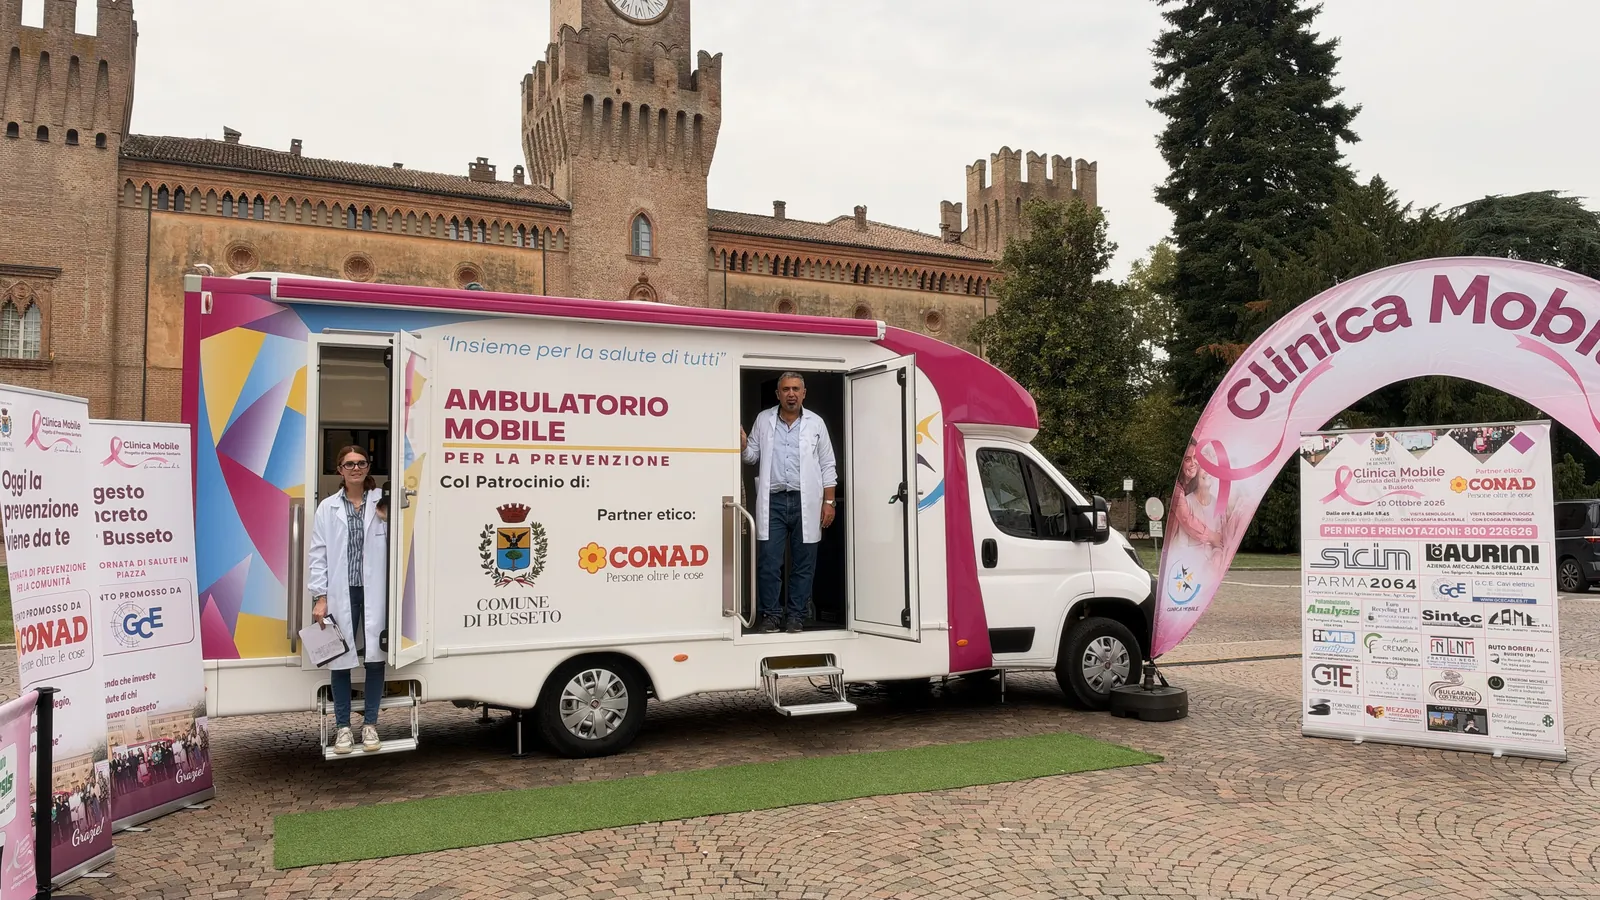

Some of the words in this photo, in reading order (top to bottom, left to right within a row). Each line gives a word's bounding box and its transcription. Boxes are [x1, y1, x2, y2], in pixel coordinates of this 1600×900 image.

[442, 335, 531, 356] “Insieme
[536, 343, 571, 360] per
[576, 343, 594, 360] la
[599, 346, 656, 364] salute
[662, 349, 678, 364] di
[684, 351, 726, 367] tutti”
[1227, 294, 1412, 420] Clinica
[1428, 274, 1600, 365] Mobi
[444, 388, 669, 417] AMBULATORIO
[42, 416, 61, 428] Clinica
[63, 419, 81, 430] Mobile
[444, 418, 566, 442] MOBILE
[123, 441, 151, 450] Clinica
[153, 442, 180, 450] Mobile
[444, 452, 485, 464] PER
[496, 453, 520, 465] LA
[530, 454, 670, 467] PREVENZIONE
[1353, 468, 1396, 478] Clinica
[1400, 467, 1445, 477] Mobile
[2, 468, 27, 496] Oggi
[30, 470, 42, 490] la
[440, 476, 470, 488] Col
[476, 476, 565, 488] Patrocinio
[570, 476, 590, 488] di:
[1468, 477, 1536, 490] CONAD
[93, 484, 144, 505] gesto
[4, 498, 79, 527] prevenzione
[597, 509, 652, 522] Partner
[656, 508, 696, 521] etico:
[103, 529, 173, 545] Busseto
[1379, 527, 1462, 535] PRENOTAZIONI:
[1489, 528, 1532, 536] 226626
[6, 529, 30, 551] viene
[33, 528, 51, 547] da
[55, 528, 70, 546] te
[99, 560, 135, 569] ORNATA
[149, 557, 178, 565] SALUTE
[609, 544, 709, 568] CONAD
[29, 568, 35, 578] DI
[37, 562, 87, 575] PREVENZIONE
[116, 570, 146, 578] PIAZZA
[606, 572, 644, 583] Persone
[647, 571, 670, 581] oltre
[672, 571, 680, 580] le
[684, 572, 704, 580] cose
[24, 582, 29, 592] LA
[31, 574, 71, 590] COMUNITÀ
[1439, 583, 1466, 598] GCE
[120, 588, 167, 599] PROMOSSO
[26, 603, 68, 619] PROMOSSO
[71, 601, 81, 610] DA
[476, 596, 550, 611] COMUNE
[1307, 605, 1360, 617] Analysis
[123, 607, 163, 639] GCE
[463, 614, 481, 628] DI
[487, 610, 562, 628] BUSSETO
[1422, 610, 1482, 625] Sintec
[20, 616, 88, 656] CONAD
[1382, 644, 1419, 653] CREMONA
[36, 654, 55, 668] oltre
[58, 650, 66, 663] le
[68, 648, 85, 660] cose
[120, 677, 131, 686] che
[132, 672, 156, 683] investe
[1312, 663, 1352, 688] GTE
[121, 692, 126, 700] di
[127, 690, 137, 699] chi
[1386, 706, 1421, 715] MEZZADRI
[176, 762, 206, 784] Grazie!
[72, 816, 104, 847] Grazie!
